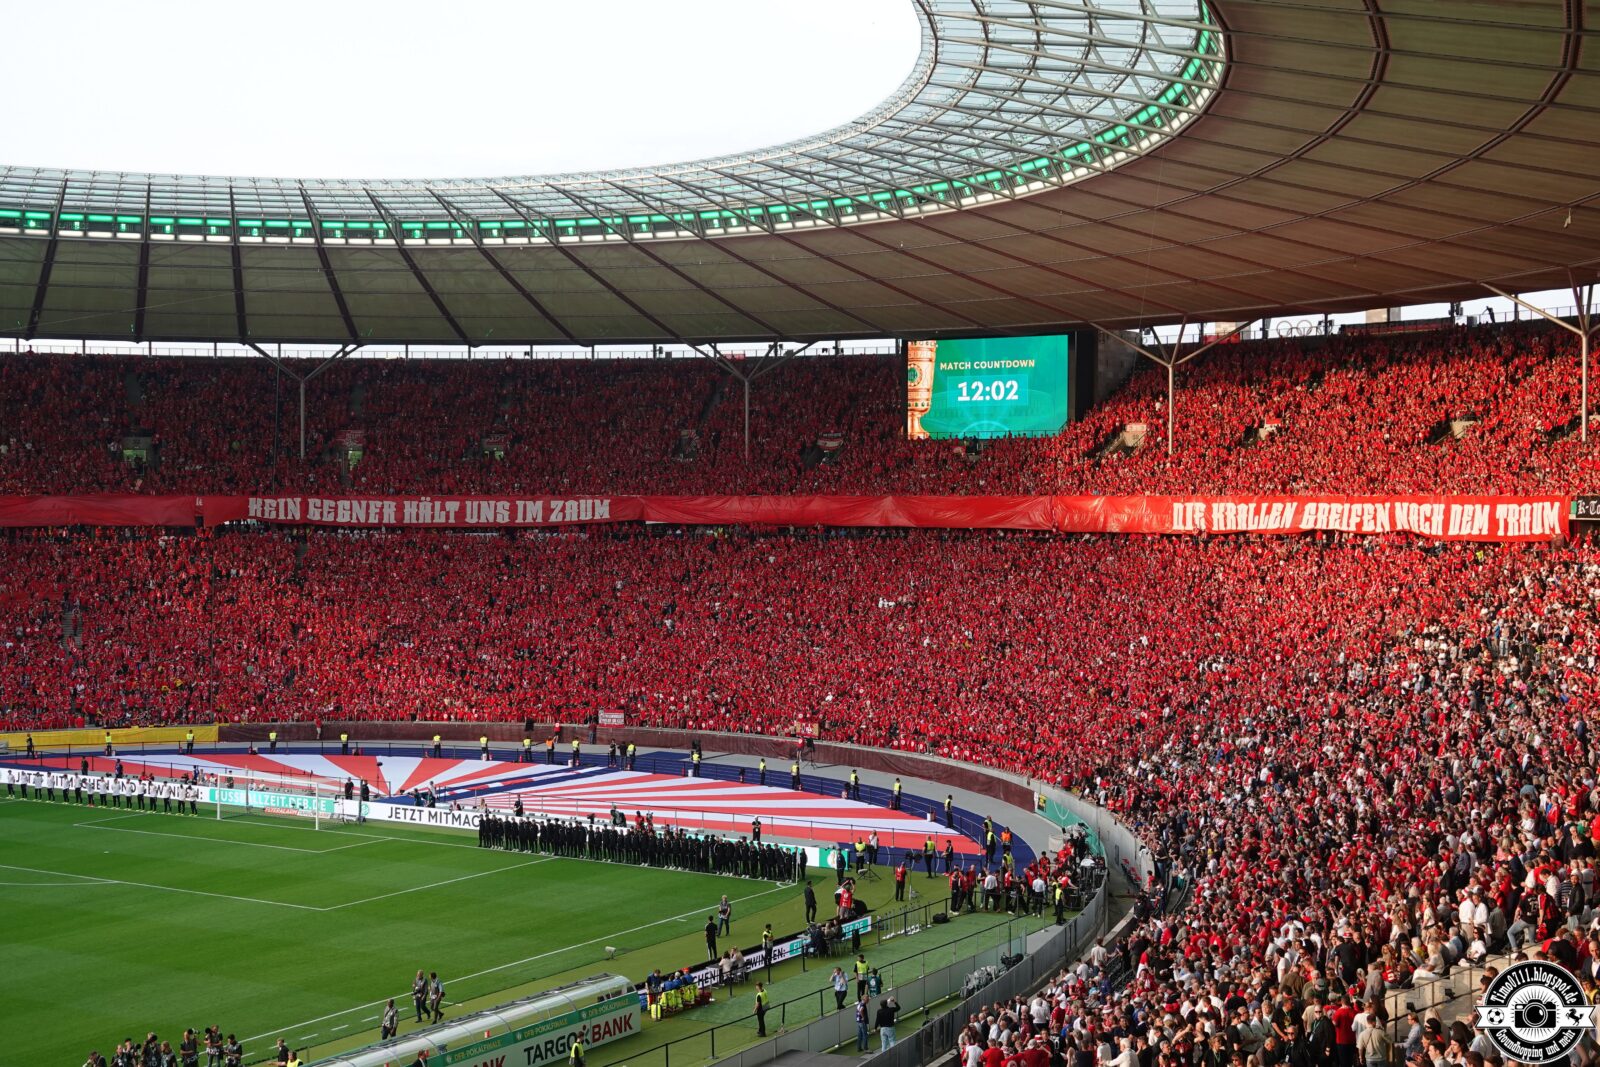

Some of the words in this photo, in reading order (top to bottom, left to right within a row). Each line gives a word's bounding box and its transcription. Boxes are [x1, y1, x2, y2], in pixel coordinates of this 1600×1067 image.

[940, 361, 971, 371] MATCH
[974, 359, 1035, 370] COUNTDOWN
[957, 380, 1019, 402] 12:02
[248, 497, 301, 520] KEIN
[307, 498, 398, 524] GEGNER
[403, 496, 460, 524] HÄLT
[465, 500, 510, 524] UNS
[515, 500, 544, 523] IM
[549, 499, 611, 522] ZAUM
[1172, 502, 1206, 531] DIE
[1211, 502, 1298, 531] KRALLEN
[1299, 502, 1391, 532] GREIFEN
[1394, 501, 1445, 535] NACH
[1448, 503, 1490, 535] DEM
[1496, 501, 1561, 536] TRAUM
[215, 790, 326, 811] FUSSALLZEIT.DFB.DE
[388, 806, 424, 822] JETZT
[524, 1031, 577, 1066] TARGO
[591, 1012, 633, 1044] BANK
